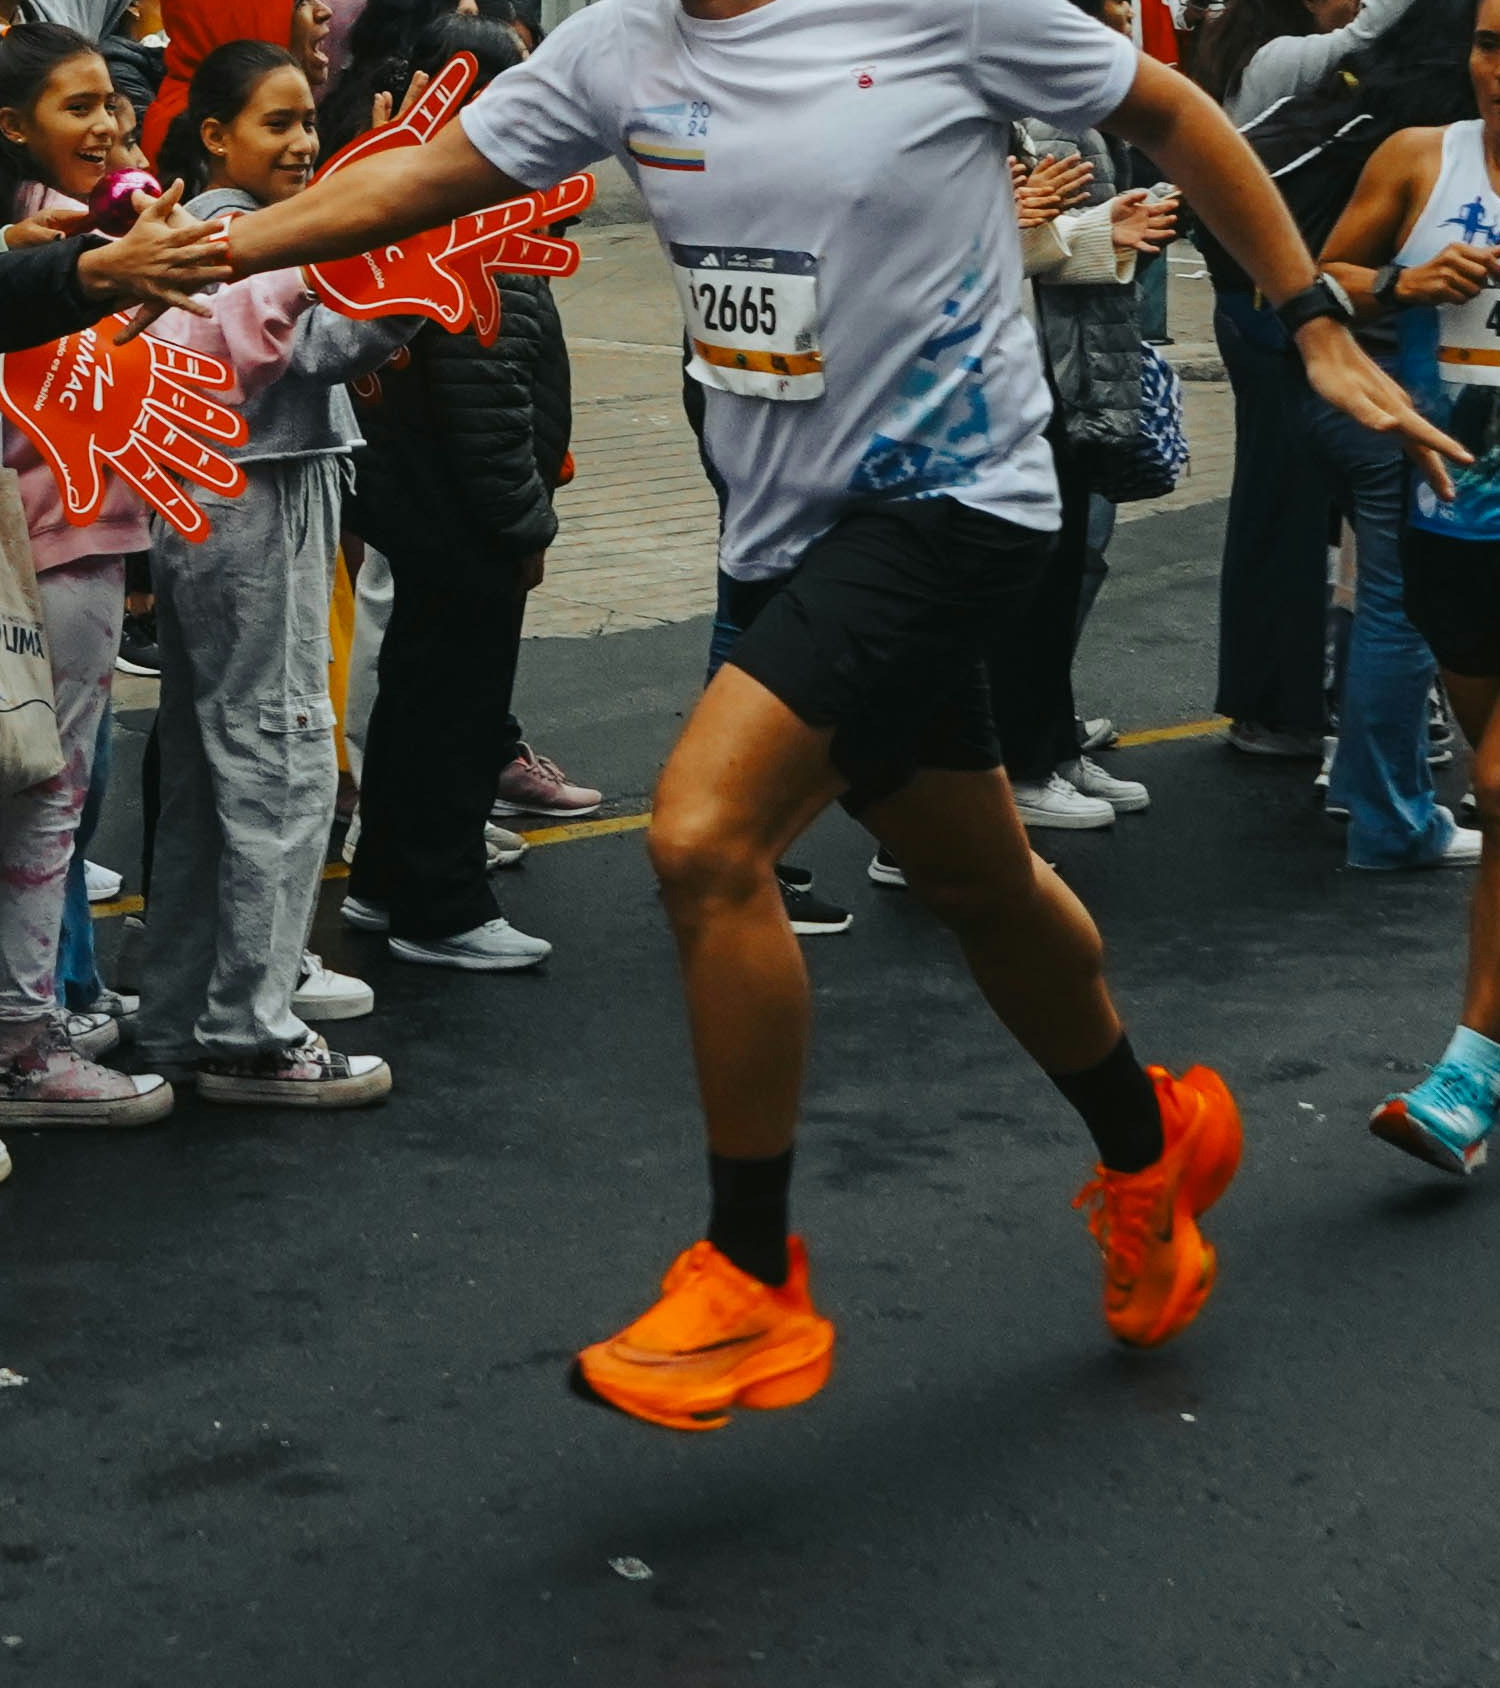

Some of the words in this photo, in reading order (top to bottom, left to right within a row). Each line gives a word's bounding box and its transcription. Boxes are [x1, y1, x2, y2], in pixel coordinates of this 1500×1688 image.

[690, 101, 711, 118] 20
[687, 120, 707, 137] 24
[699, 282, 777, 336] 2665
[56, 336, 69, 357] odo
[58, 327, 97, 412] RIMAC
[33, 371, 55, 411] posible
